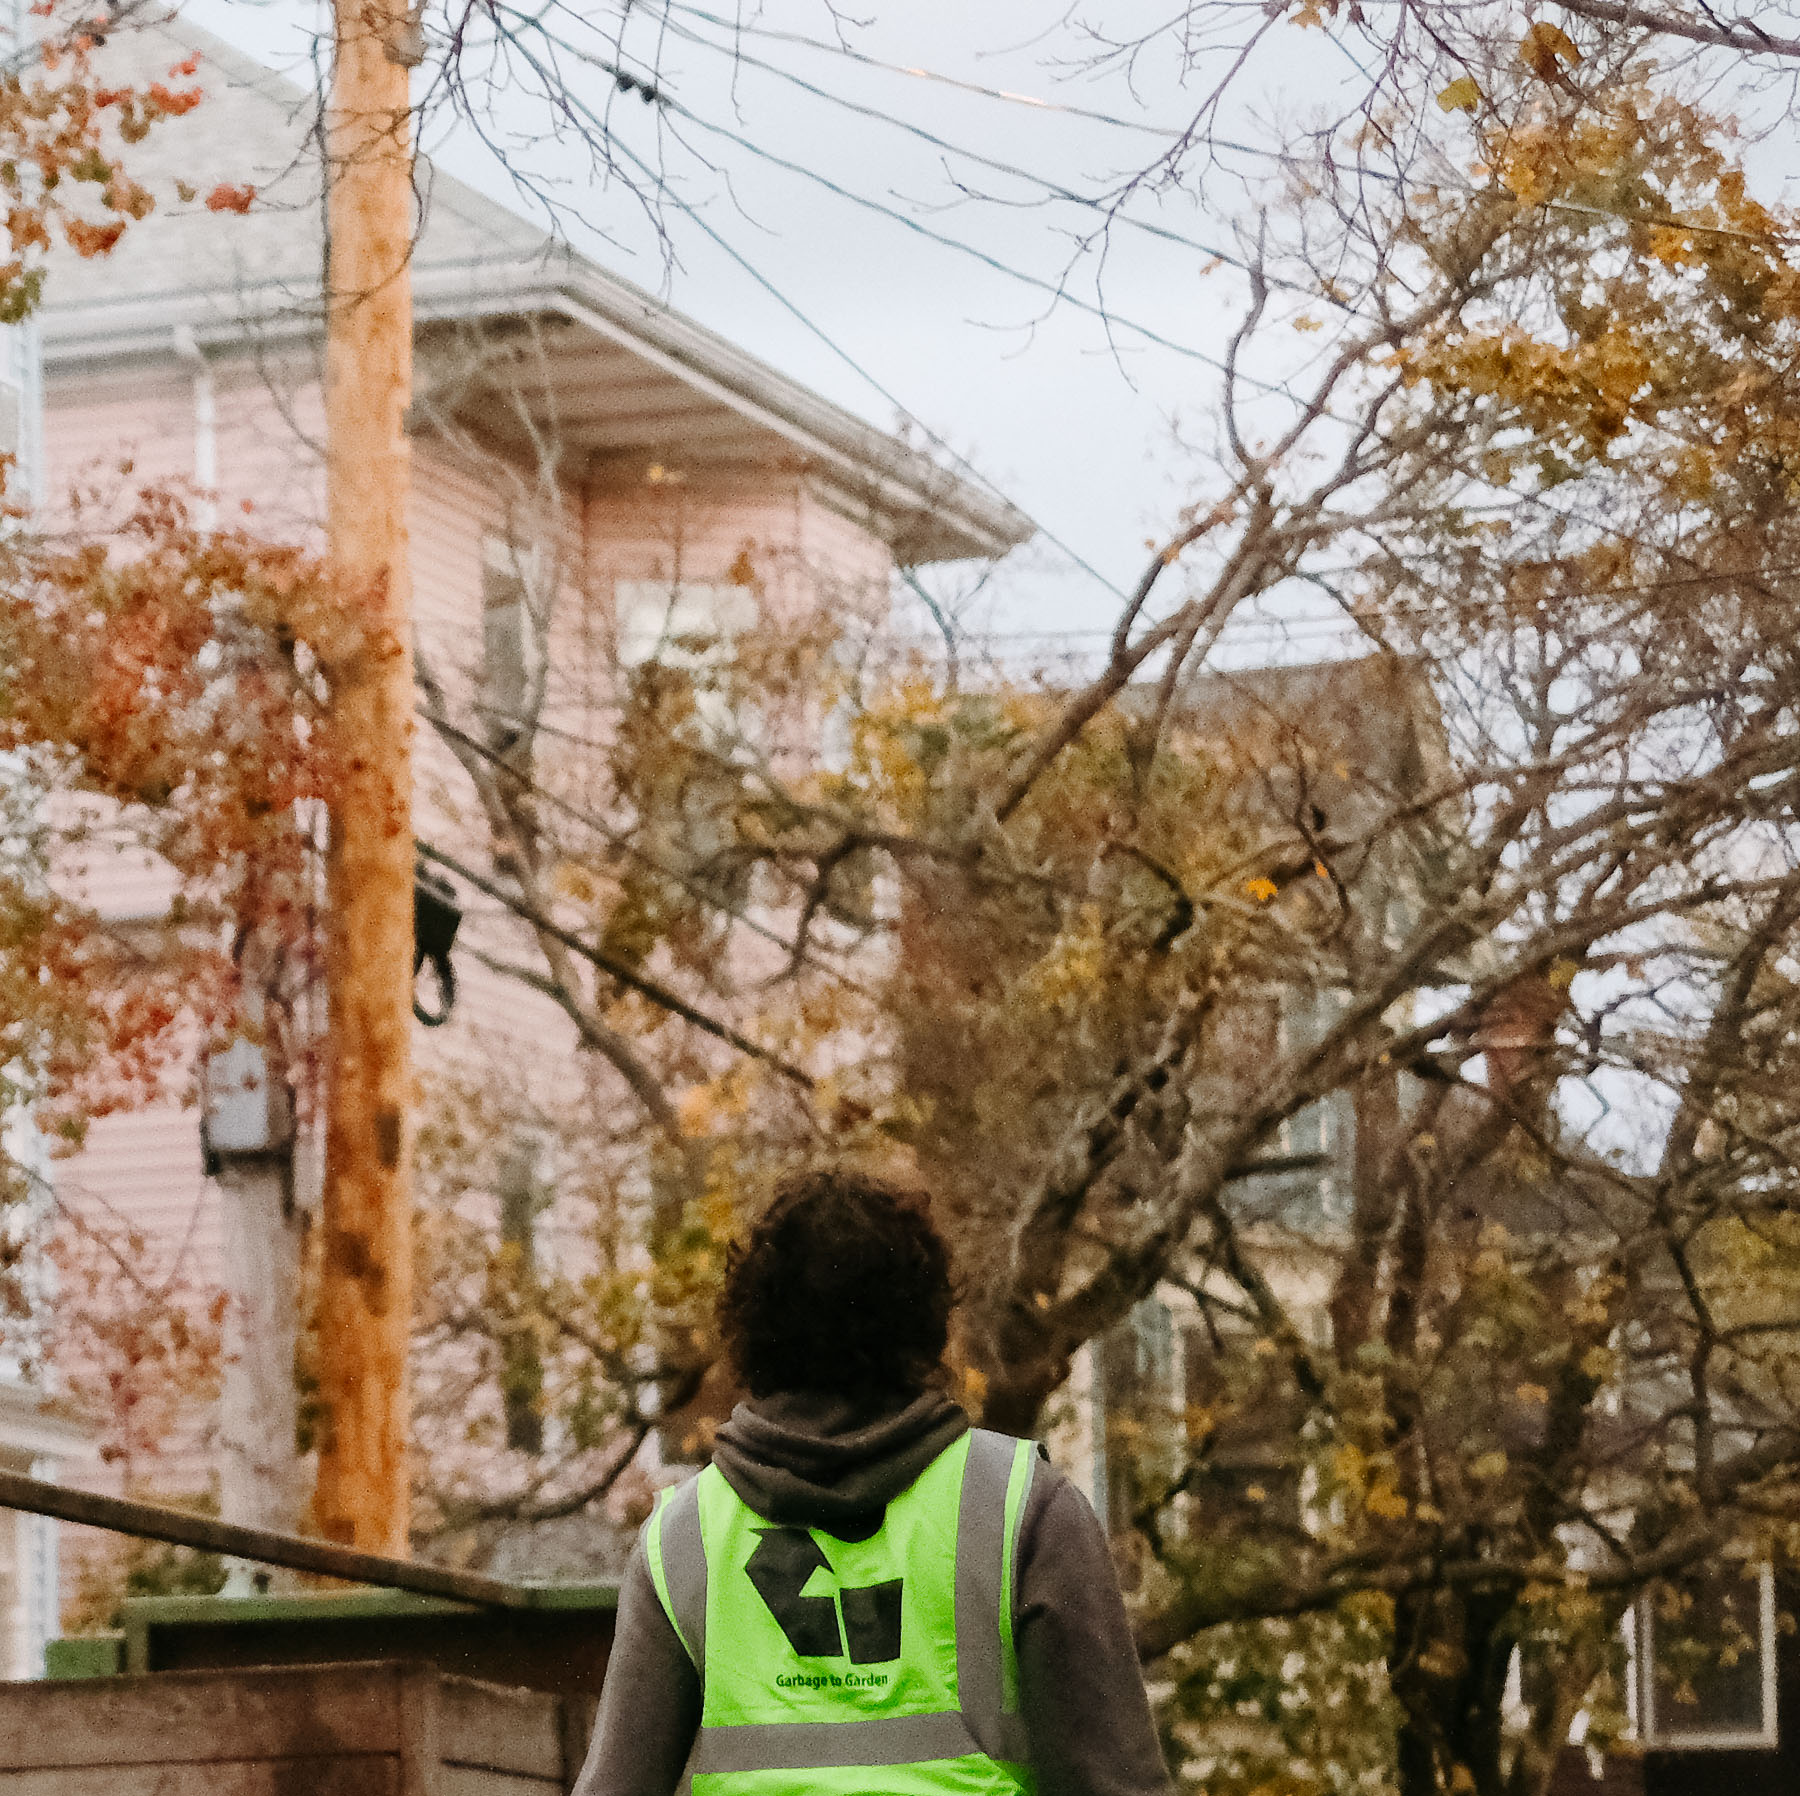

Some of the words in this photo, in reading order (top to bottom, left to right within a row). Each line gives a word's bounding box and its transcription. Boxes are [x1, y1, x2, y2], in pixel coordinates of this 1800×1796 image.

[775, 1672, 829, 1690] Garbage
[828, 1673, 843, 1687] to
[844, 1672, 889, 1688] Garden
